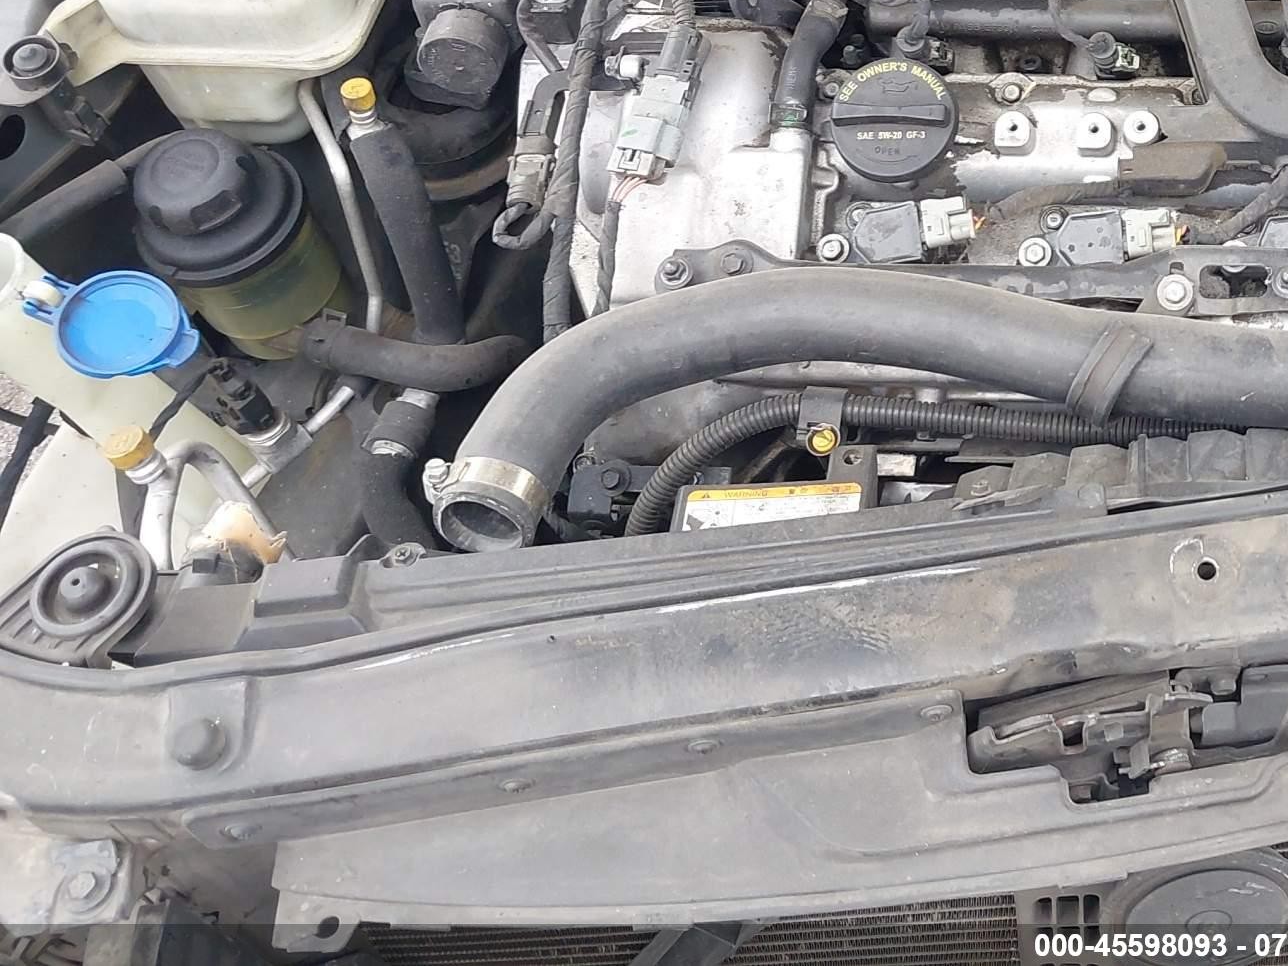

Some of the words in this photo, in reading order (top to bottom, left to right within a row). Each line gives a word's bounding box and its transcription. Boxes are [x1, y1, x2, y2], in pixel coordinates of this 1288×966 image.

[839, 81, 859, 102] SEE
[857, 62, 908, 82] OWNER'S
[911, 65, 947, 100] MANUAL
[856, 132, 874, 140] SAE
[906, 130, 926, 139] GF-3
[874, 145, 900, 155] OPEN
[724, 489, 768, 499] WARNING
